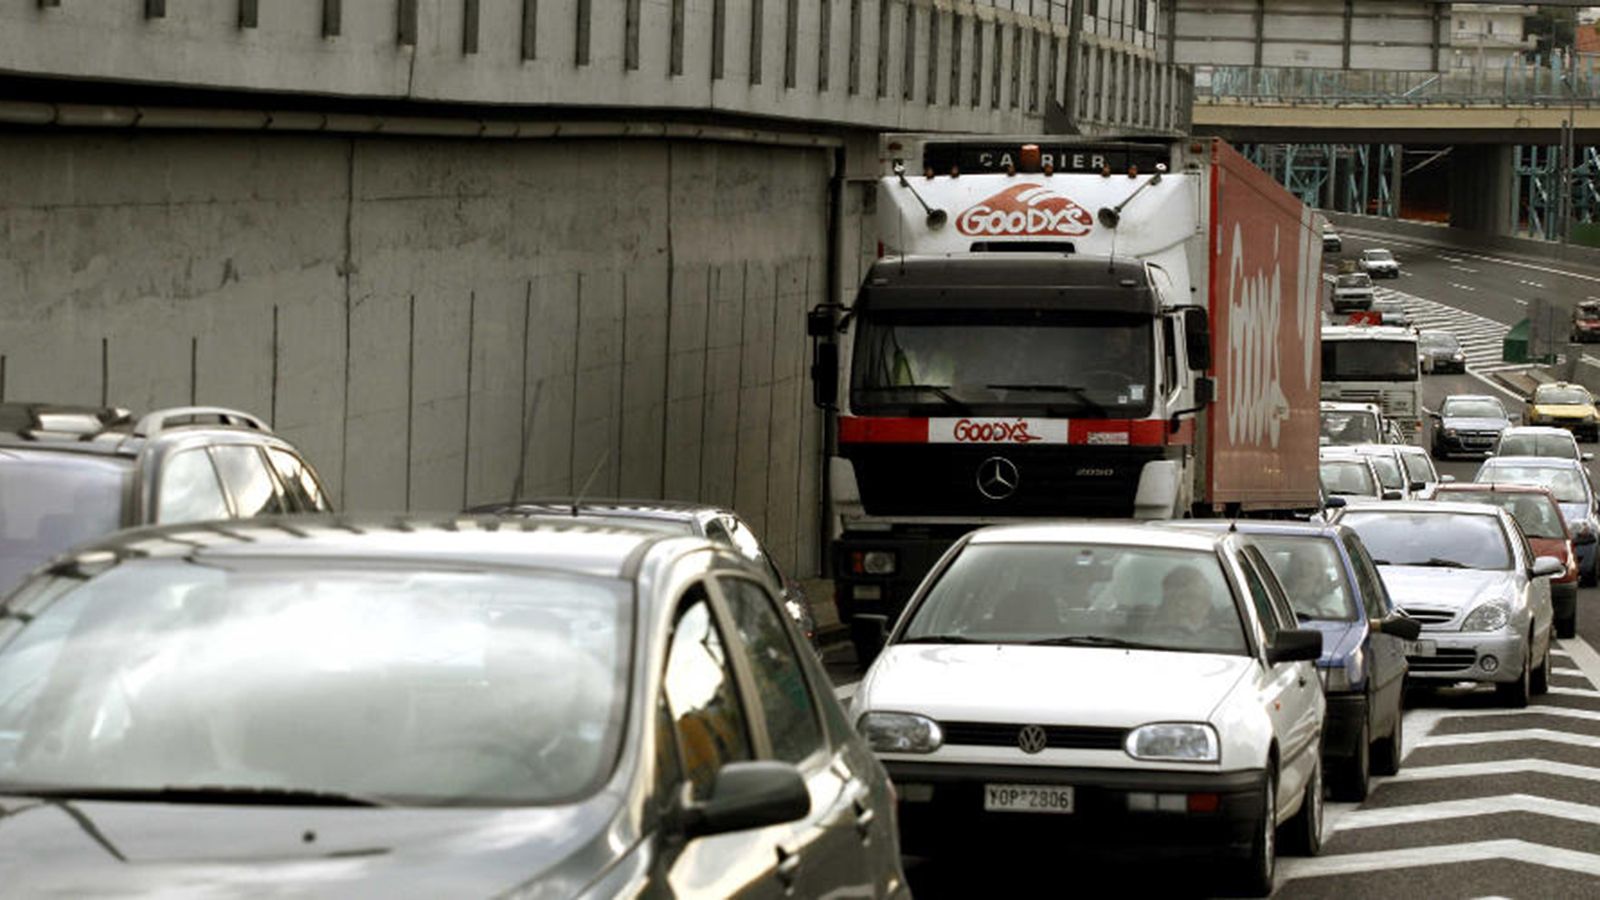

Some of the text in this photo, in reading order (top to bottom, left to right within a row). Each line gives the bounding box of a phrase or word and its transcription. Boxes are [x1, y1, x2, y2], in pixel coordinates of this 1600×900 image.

[980, 153, 1105, 169] CARIER
[962, 203, 1093, 235] GOODY'S
[953, 418, 1043, 441] GOODY'S
